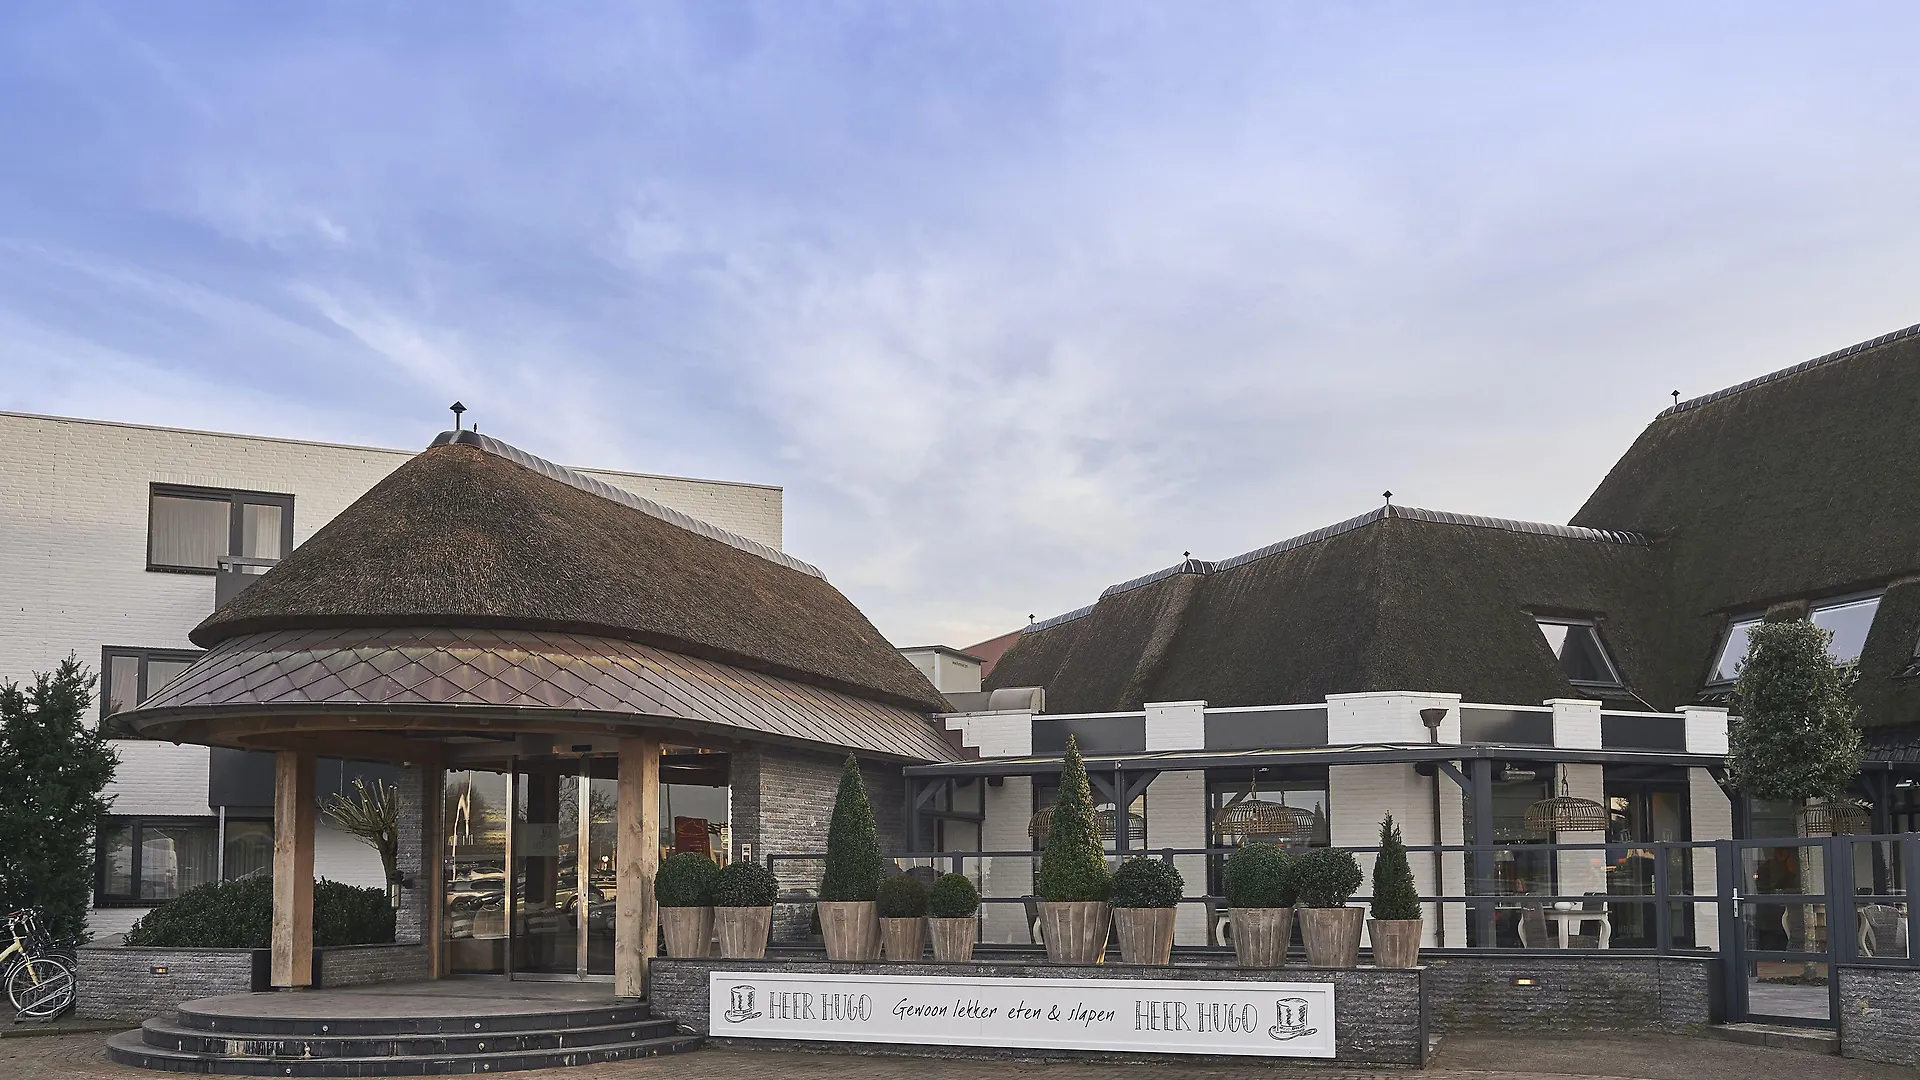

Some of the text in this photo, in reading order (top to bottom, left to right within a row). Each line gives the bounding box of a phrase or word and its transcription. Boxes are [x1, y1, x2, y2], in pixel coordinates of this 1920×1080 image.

[769, 992, 872, 1021] HEER HUGO
[892, 998, 1115, 1028] Gewoon lekker eten & slapen
[1135, 1001, 1257, 1033] HEER HUGO
